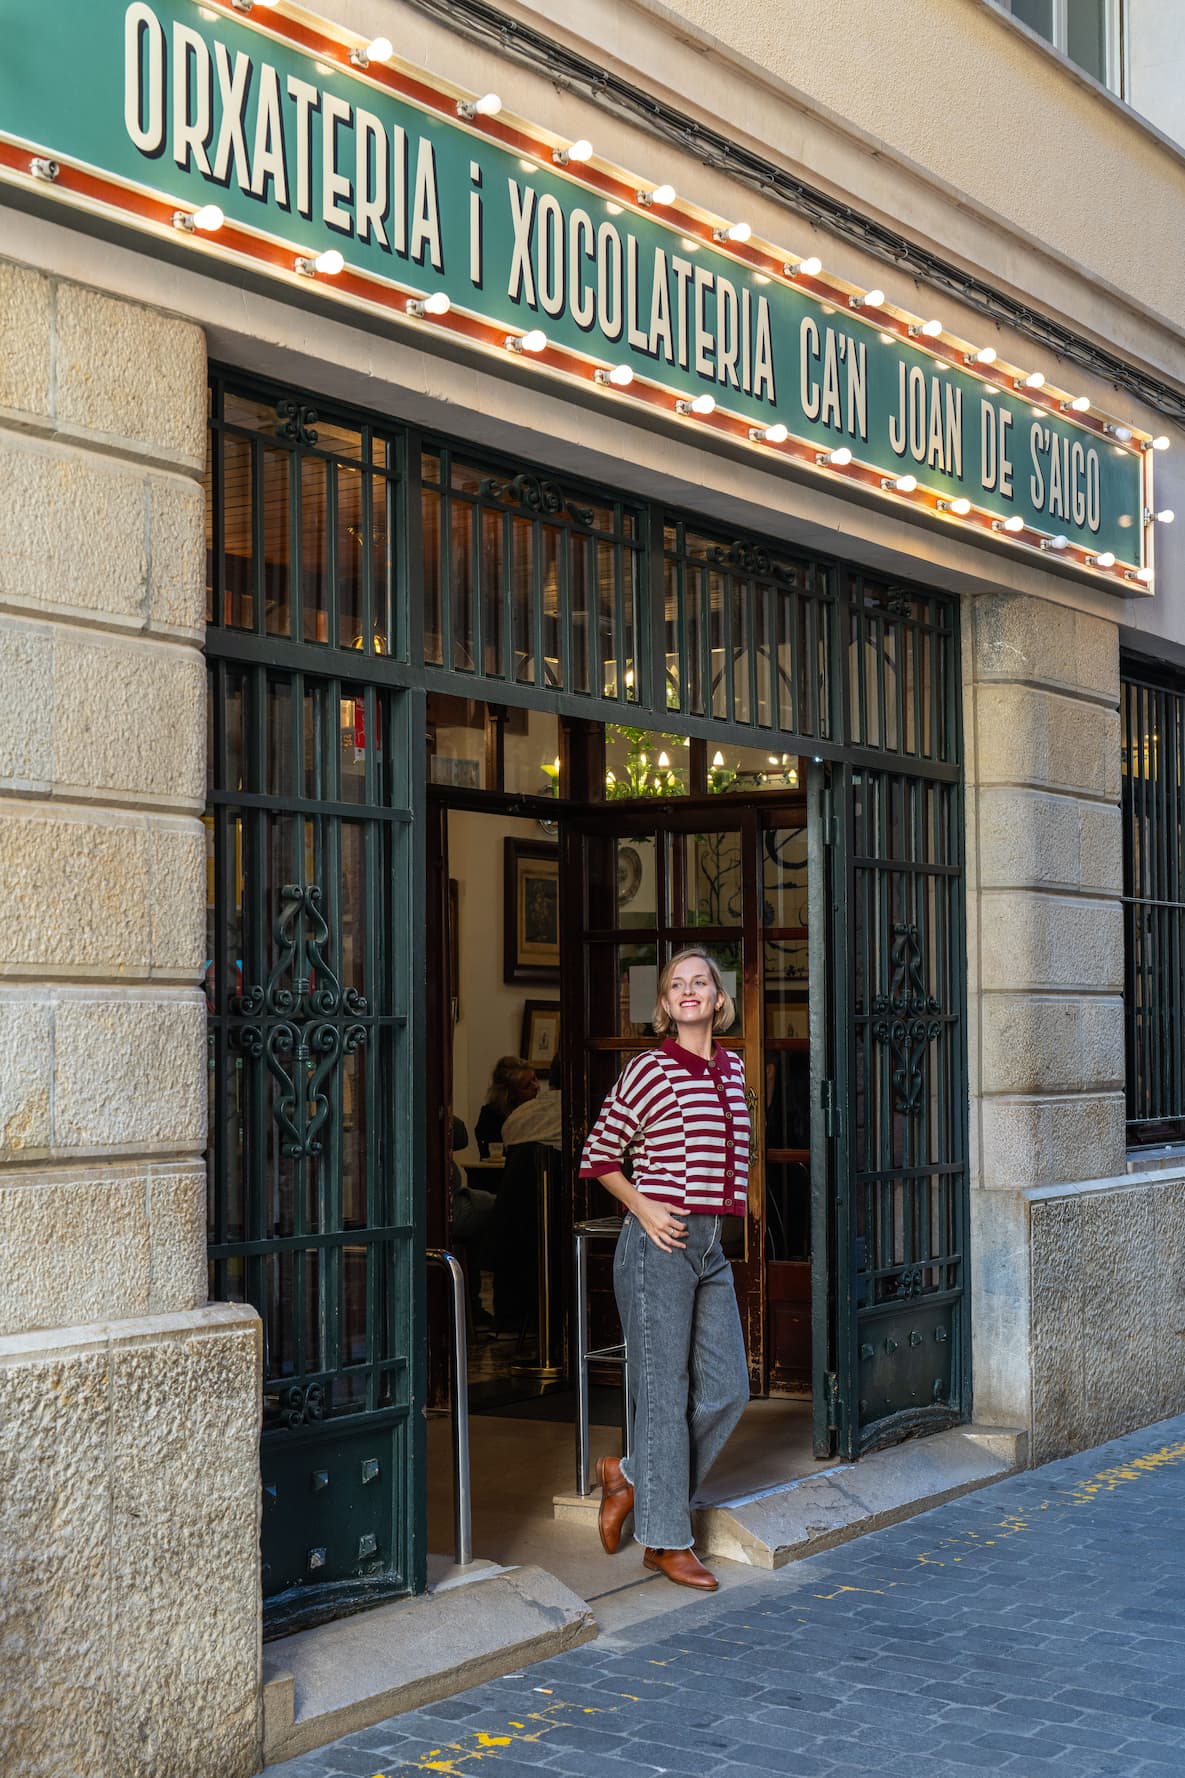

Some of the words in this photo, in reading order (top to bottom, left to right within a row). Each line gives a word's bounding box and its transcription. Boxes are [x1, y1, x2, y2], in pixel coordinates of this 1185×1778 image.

[125, 2, 442, 269] ORXATERIA
[470, 161, 481, 284] i
[508, 178, 775, 402] XOCOLATERIA
[800, 317, 867, 438] CA'N
[889, 360, 963, 478] JOAN
[981, 399, 1014, 498] DE
[1030, 422, 1100, 532] S'AIGO
